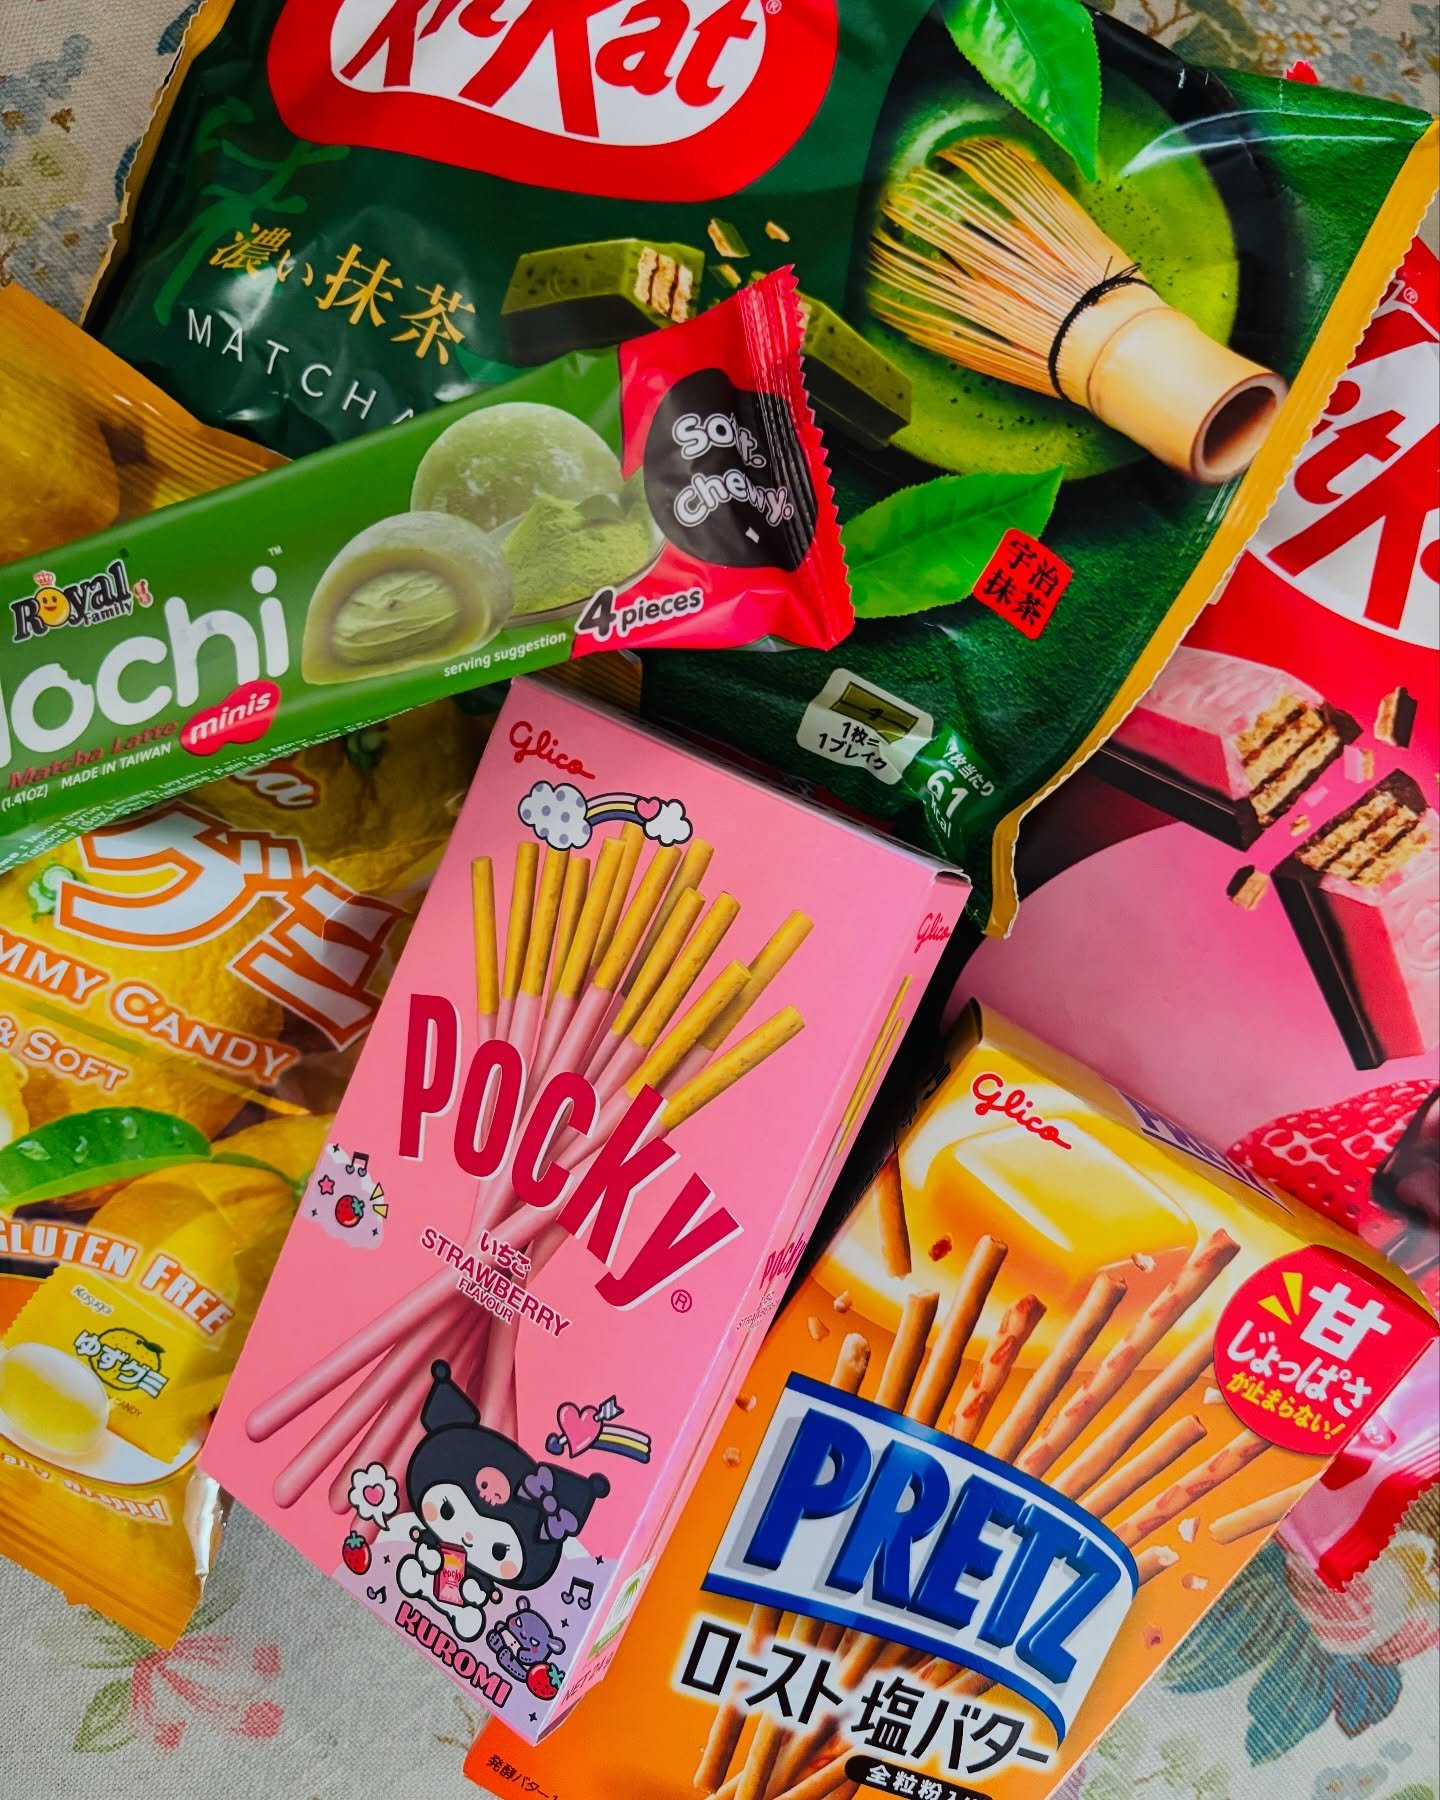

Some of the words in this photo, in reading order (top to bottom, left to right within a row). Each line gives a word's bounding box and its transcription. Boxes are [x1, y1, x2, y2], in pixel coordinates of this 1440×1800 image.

[209, 223, 476, 366] 濃い抹茶
[674, 469, 794, 527] Chewy.
[983, 568, 1046, 626] 抹茶
[1007, 540, 1059, 598] 宇治
[10, 559, 132, 643] Royal
[576, 587, 616, 640] 4
[620, 588, 702, 634] pieces
[0, 565, 290, 768] ochi
[443, 653, 492, 677] serving
[494, 632, 567, 663] suggestion
[189, 691, 273, 745] minis
[8, 745, 104, 791] Matcha
[111, 719, 180, 755] Latte
[61, 765, 98, 790] MADE
[102, 761, 117, 776] IN
[120, 742, 172, 769] TAIWAN
[508, 720, 596, 780] Glico
[818, 732, 888, 770] 1ブレイク
[927, 768, 969, 820] 61
[914, 912, 951, 954] Glico
[24, 1031, 128, 1090] SOFT
[114, 985, 292, 1079] CANDY
[972, 1073, 1072, 1150] Glico
[419, 1227, 571, 1338] STRAWBERRY
[480, 1231, 533, 1280] いちご
[142, 1254, 234, 1334] FREE
[458, 1277, 515, 1325] FLAVOUR
[1299, 1281, 1392, 1362] 甘
[73, 1329, 170, 1399] ゆずグミ
[1226, 1319, 1373, 1418] じょっぱさ
[1226, 1371, 1347, 1441] が止まらない!
[742, 1407, 1122, 1685] PRETZ
[394, 1600, 513, 1708] KUROMI
[485, 1753, 559, 1800] 発酵バター
[865, 1764, 980, 1800] 全粒粉
